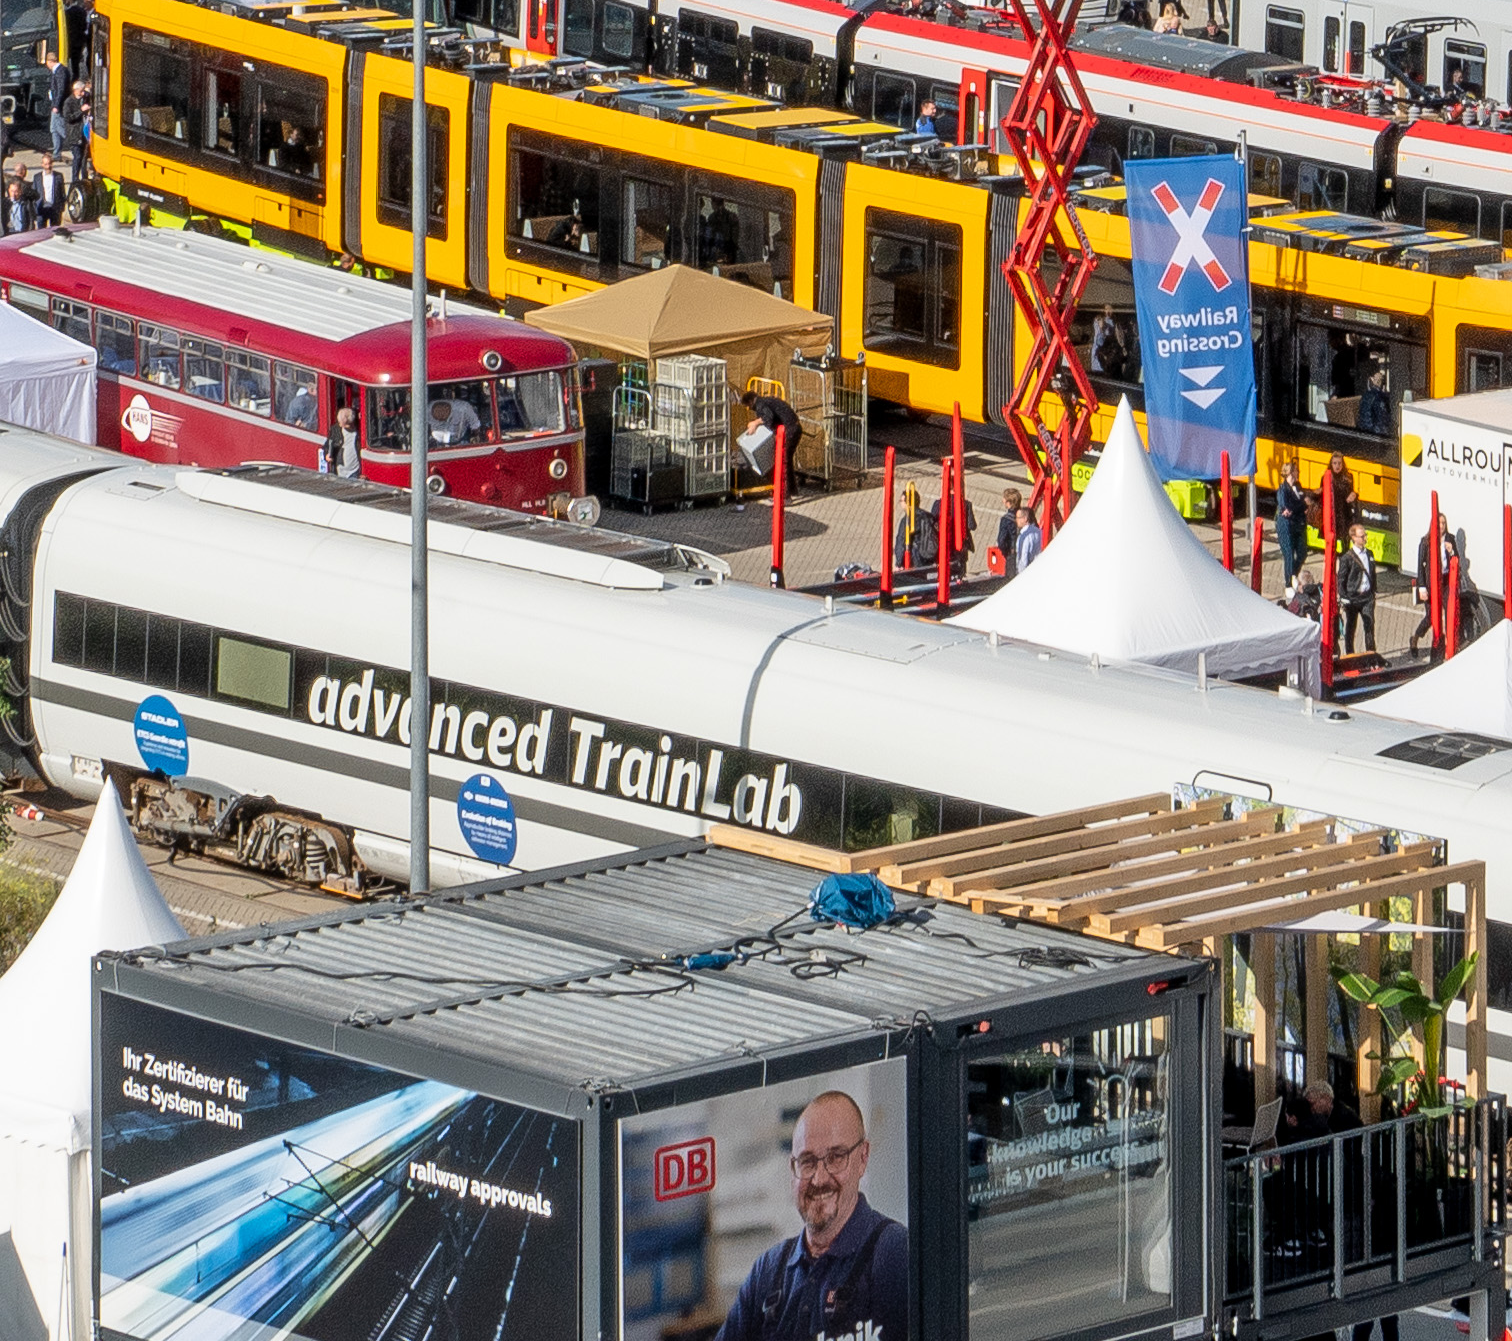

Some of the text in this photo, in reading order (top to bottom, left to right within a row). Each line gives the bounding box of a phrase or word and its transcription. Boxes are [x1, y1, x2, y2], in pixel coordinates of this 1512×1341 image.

[140, 711, 180, 729] STADLER
[309, 670, 803, 835] advanced TrainLab
[123, 1046, 249, 1101] Ihr Zertifizierer für
[123, 1075, 243, 1129] das System Bahn
[1045, 1100, 1081, 1124] Our
[991, 1121, 1093, 1162] knowledge
[409, 1160, 552, 1217] railway approvals
[661, 1146, 710, 1193] DB
[1006, 1165, 1022, 1184] is
[1024, 1157, 1067, 1192] your
